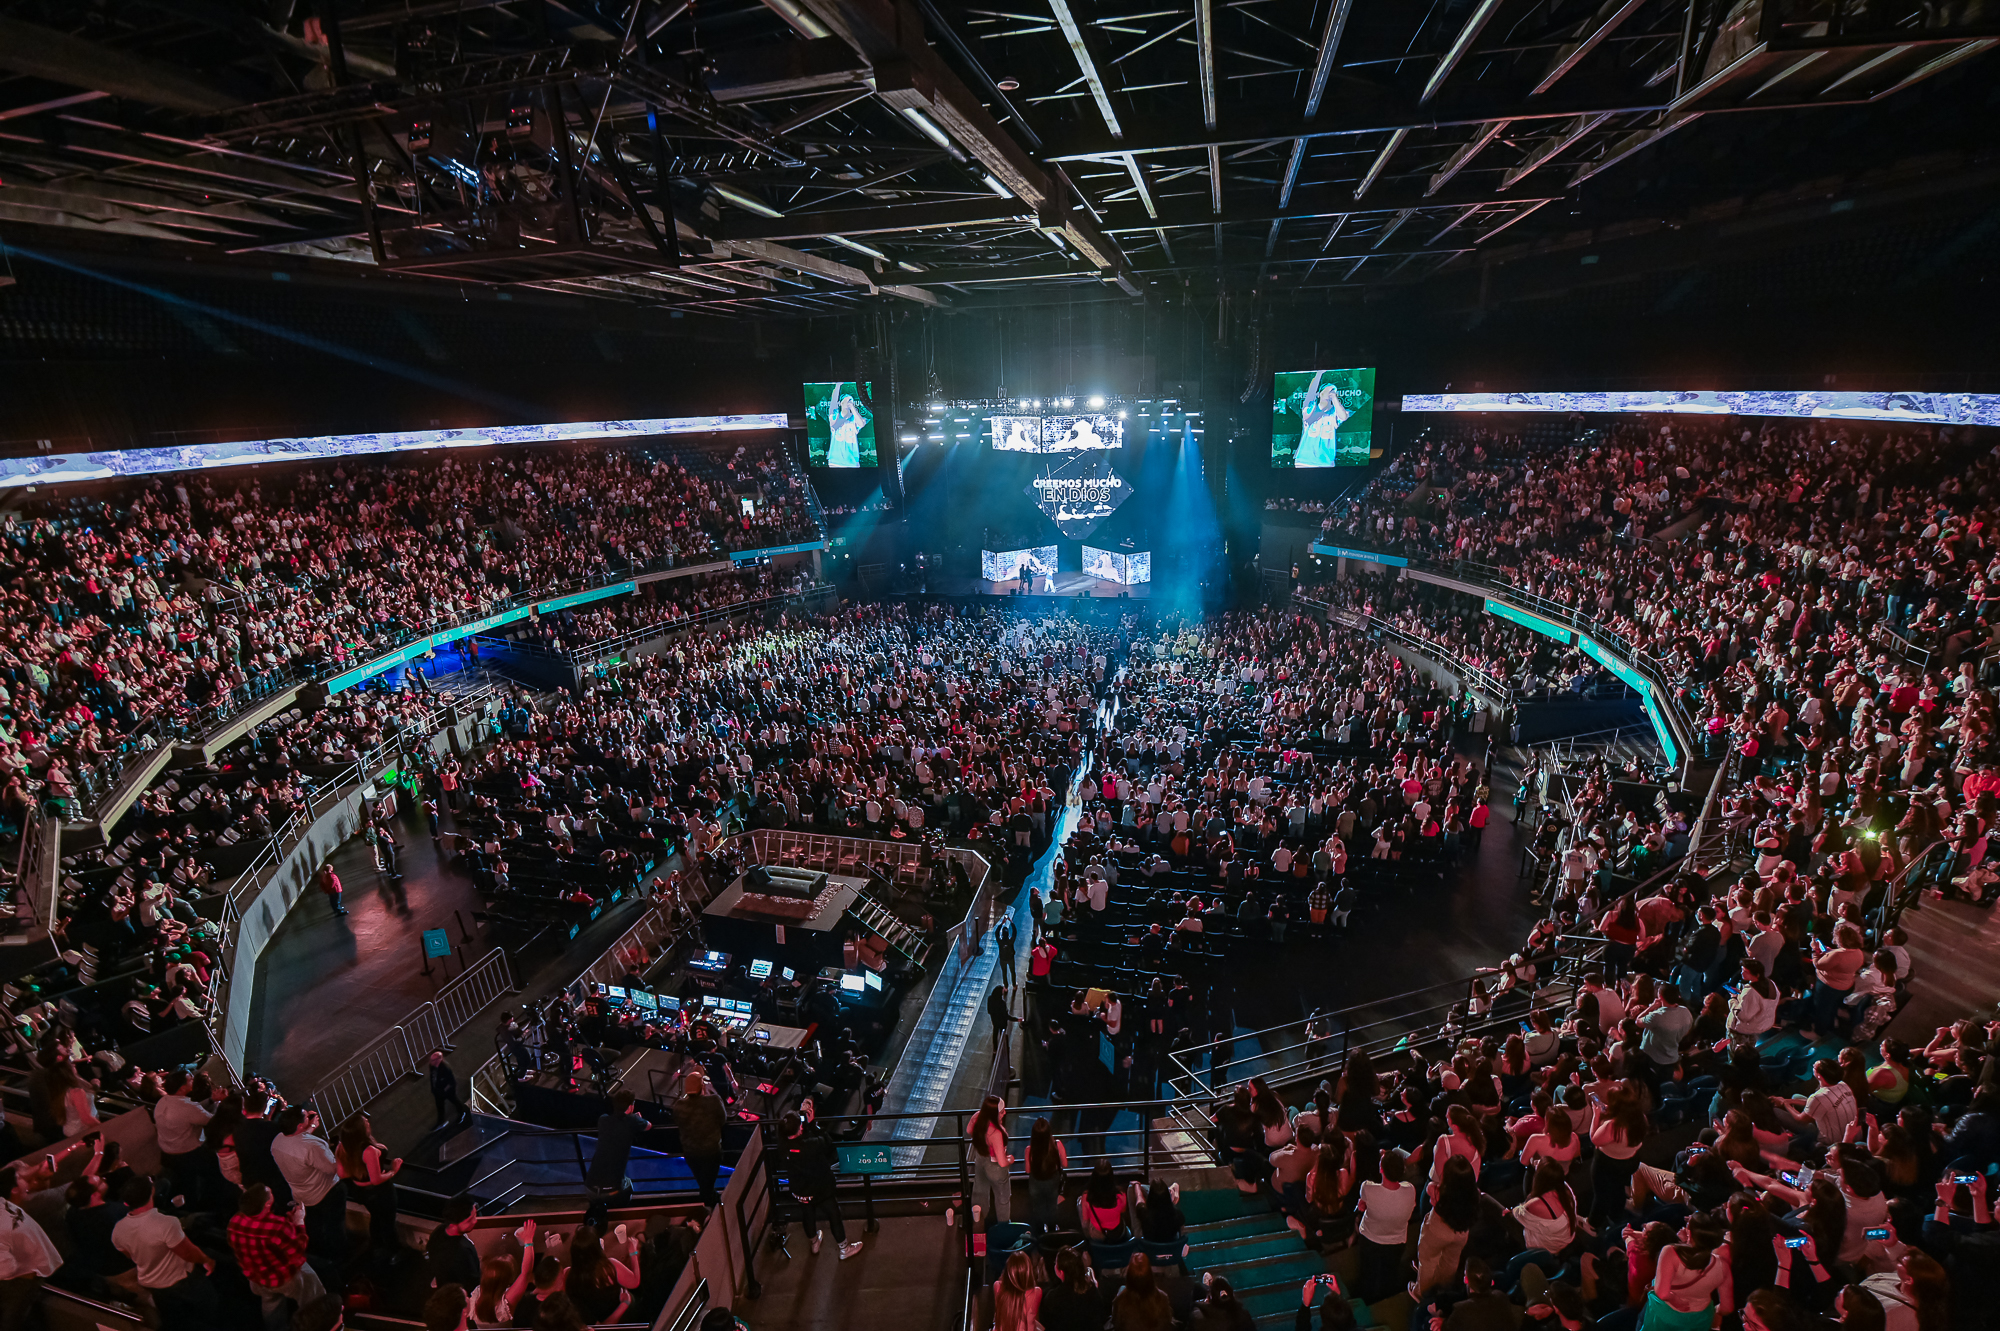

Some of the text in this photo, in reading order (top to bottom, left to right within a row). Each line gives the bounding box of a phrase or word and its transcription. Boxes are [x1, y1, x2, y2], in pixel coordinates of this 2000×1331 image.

[1032, 478, 1122, 488] CREEMOS MUCHO
[1044, 488, 1111, 502] EN DIOS
[462, 621, 485, 633] SALIDA
[490, 615, 503, 624] EXIT
[587, 1006, 598, 1014] 21
